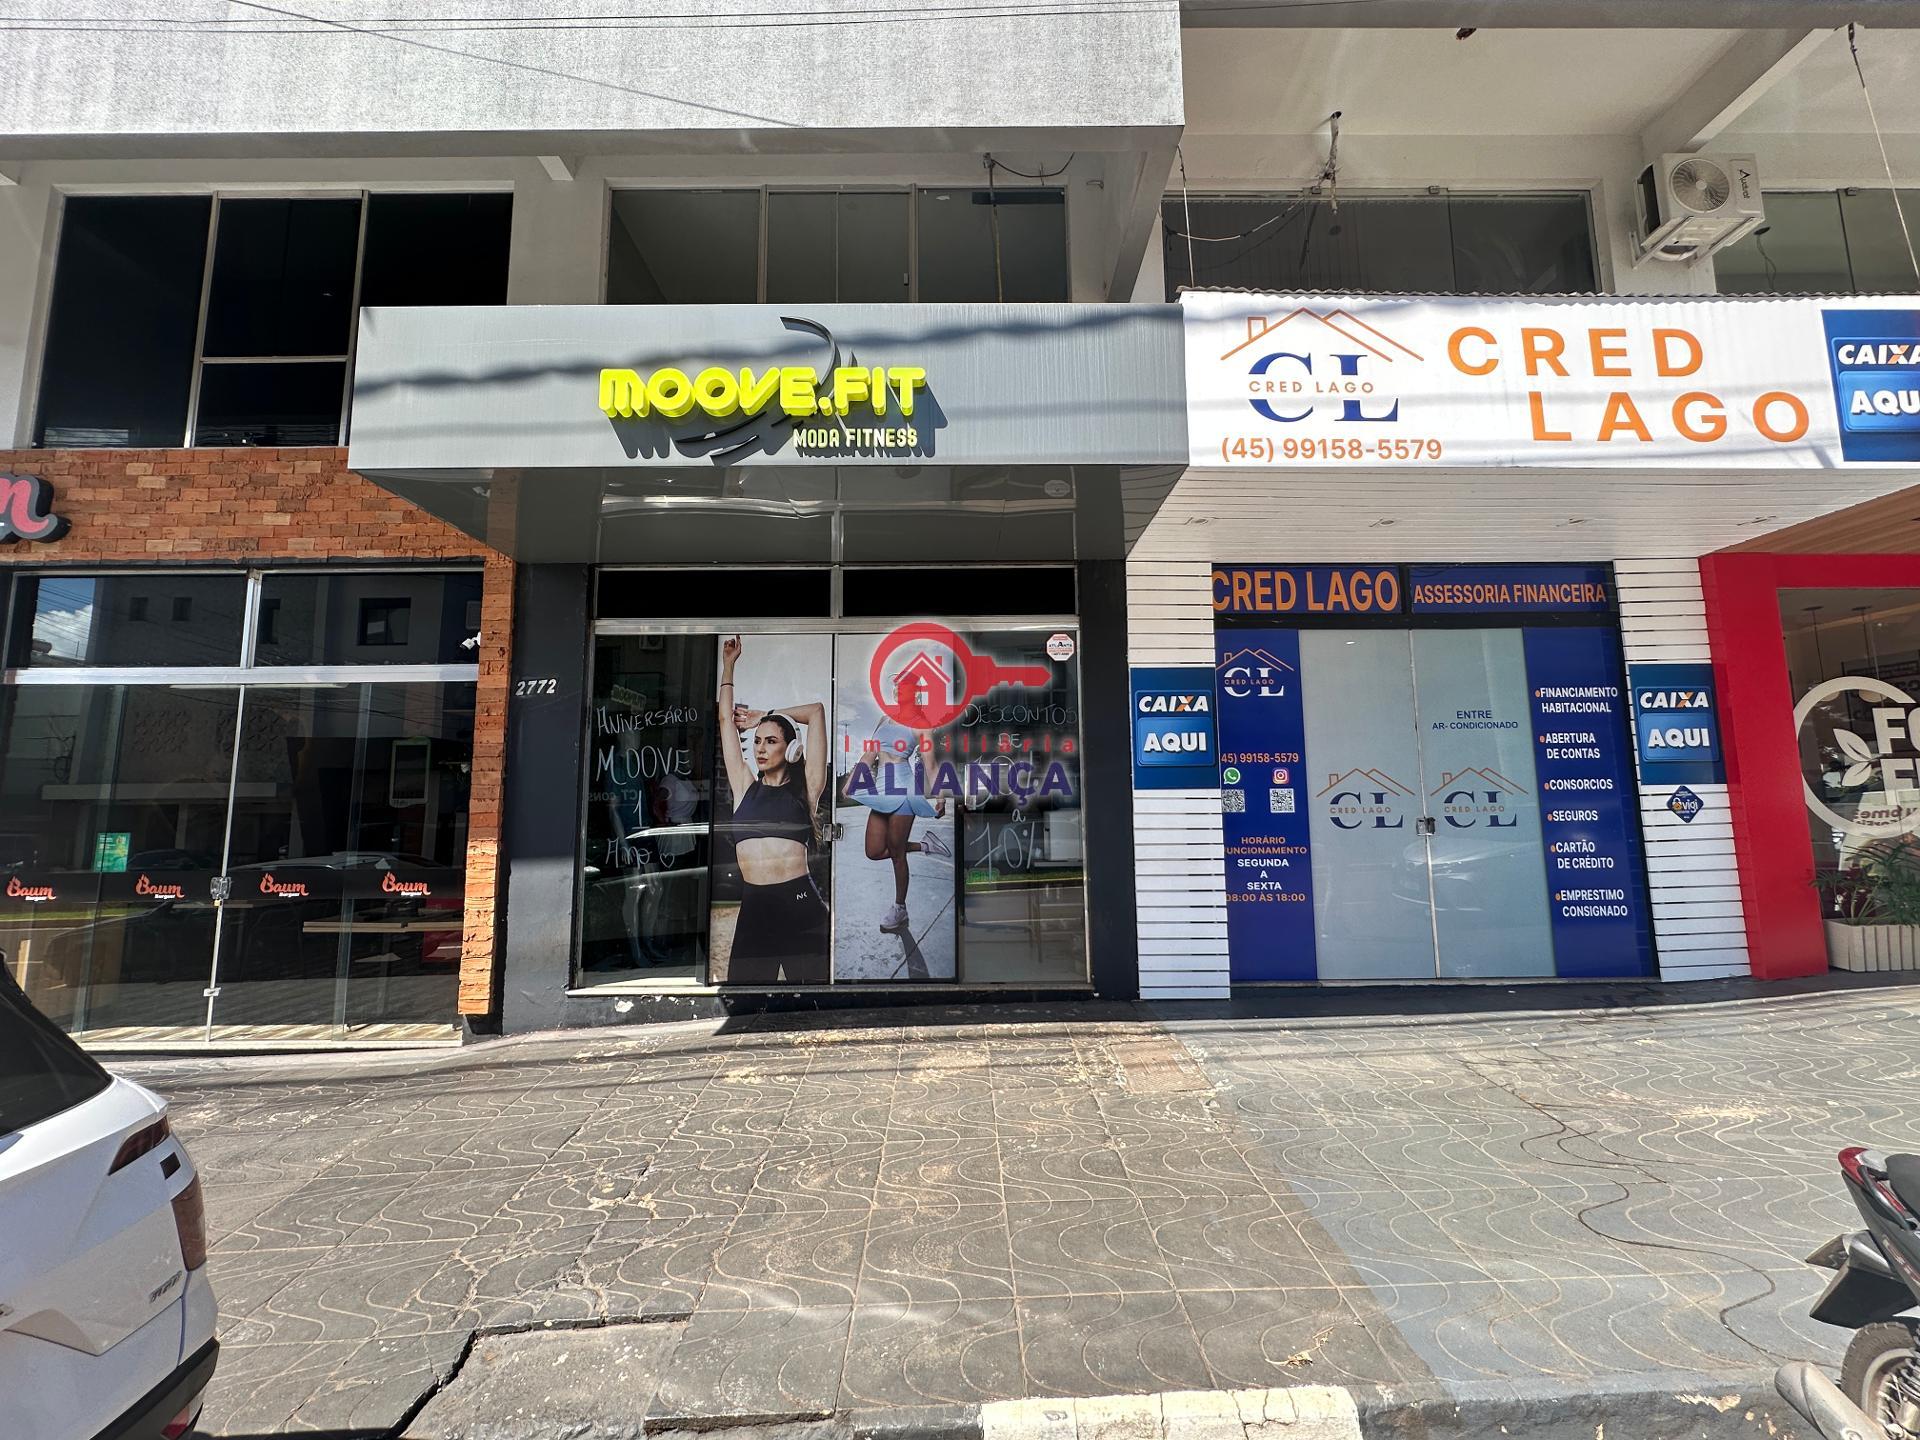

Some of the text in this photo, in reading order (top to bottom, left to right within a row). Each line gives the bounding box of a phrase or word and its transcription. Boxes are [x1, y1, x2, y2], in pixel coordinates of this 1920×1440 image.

[1447, 327, 1703, 377] CRED
[599, 366, 928, 418] MOOVE.FIT
[1249, 381, 1373, 393] CRED LAGO
[1528, 391, 1809, 442] LAGO
[793, 428, 918, 448] MODA FITNESS
[1221, 437, 1442, 462] (45) 99158-5579
[1213, 571, 1399, 611] CRED LAGO
[1413, 583, 1607, 604] ASSESSORIA FINANCEIRA
[515, 678, 557, 696] 2772
[1540, 686, 1618, 698] FINANCIAMENTO
[1138, 695, 1209, 712] CAIXA
[1640, 691, 1709, 708] CAIXA
[1456, 710, 1493, 719] ENTRE
[1541, 702, 1611, 713] HABITACIONAL
[961, 704, 1077, 727] DESCONTOS
[1450, 721, 1518, 730] CONDICIONADO
[1143, 732, 1206, 753] AQUI
[1545, 732, 1596, 744] ABERTURA
[1648, 728, 1710, 748] AQUI
[1240, 753, 1299, 763] 99158-5579
[1547, 748, 1600, 758] DE CONTAS
[596, 745, 692, 785] MOOVE
[1549, 779, 1613, 790] CONSORCIOS
[1552, 810, 1598, 821] SEGUROS
[1241, 835, 1286, 845] HORÁRIO
[1556, 839, 1595, 852] CARTÃO
[1237, 858, 1289, 867] SEGUNDA
[1558, 855, 1614, 869] DE CRÉDITO
[1260, 870, 1268, 878] A
[6, 876, 57, 900] Baum
[136, 874, 185, 898] Baum
[260, 873, 309, 896] Baum
[382, 871, 431, 896] Baum
[1246, 882, 1282, 890] SEXTA
[1276, 894, 1306, 902] 18:00
[1560, 889, 1624, 901] EMPRESTIMO
[1562, 905, 1628, 917] CONSIGNADO
